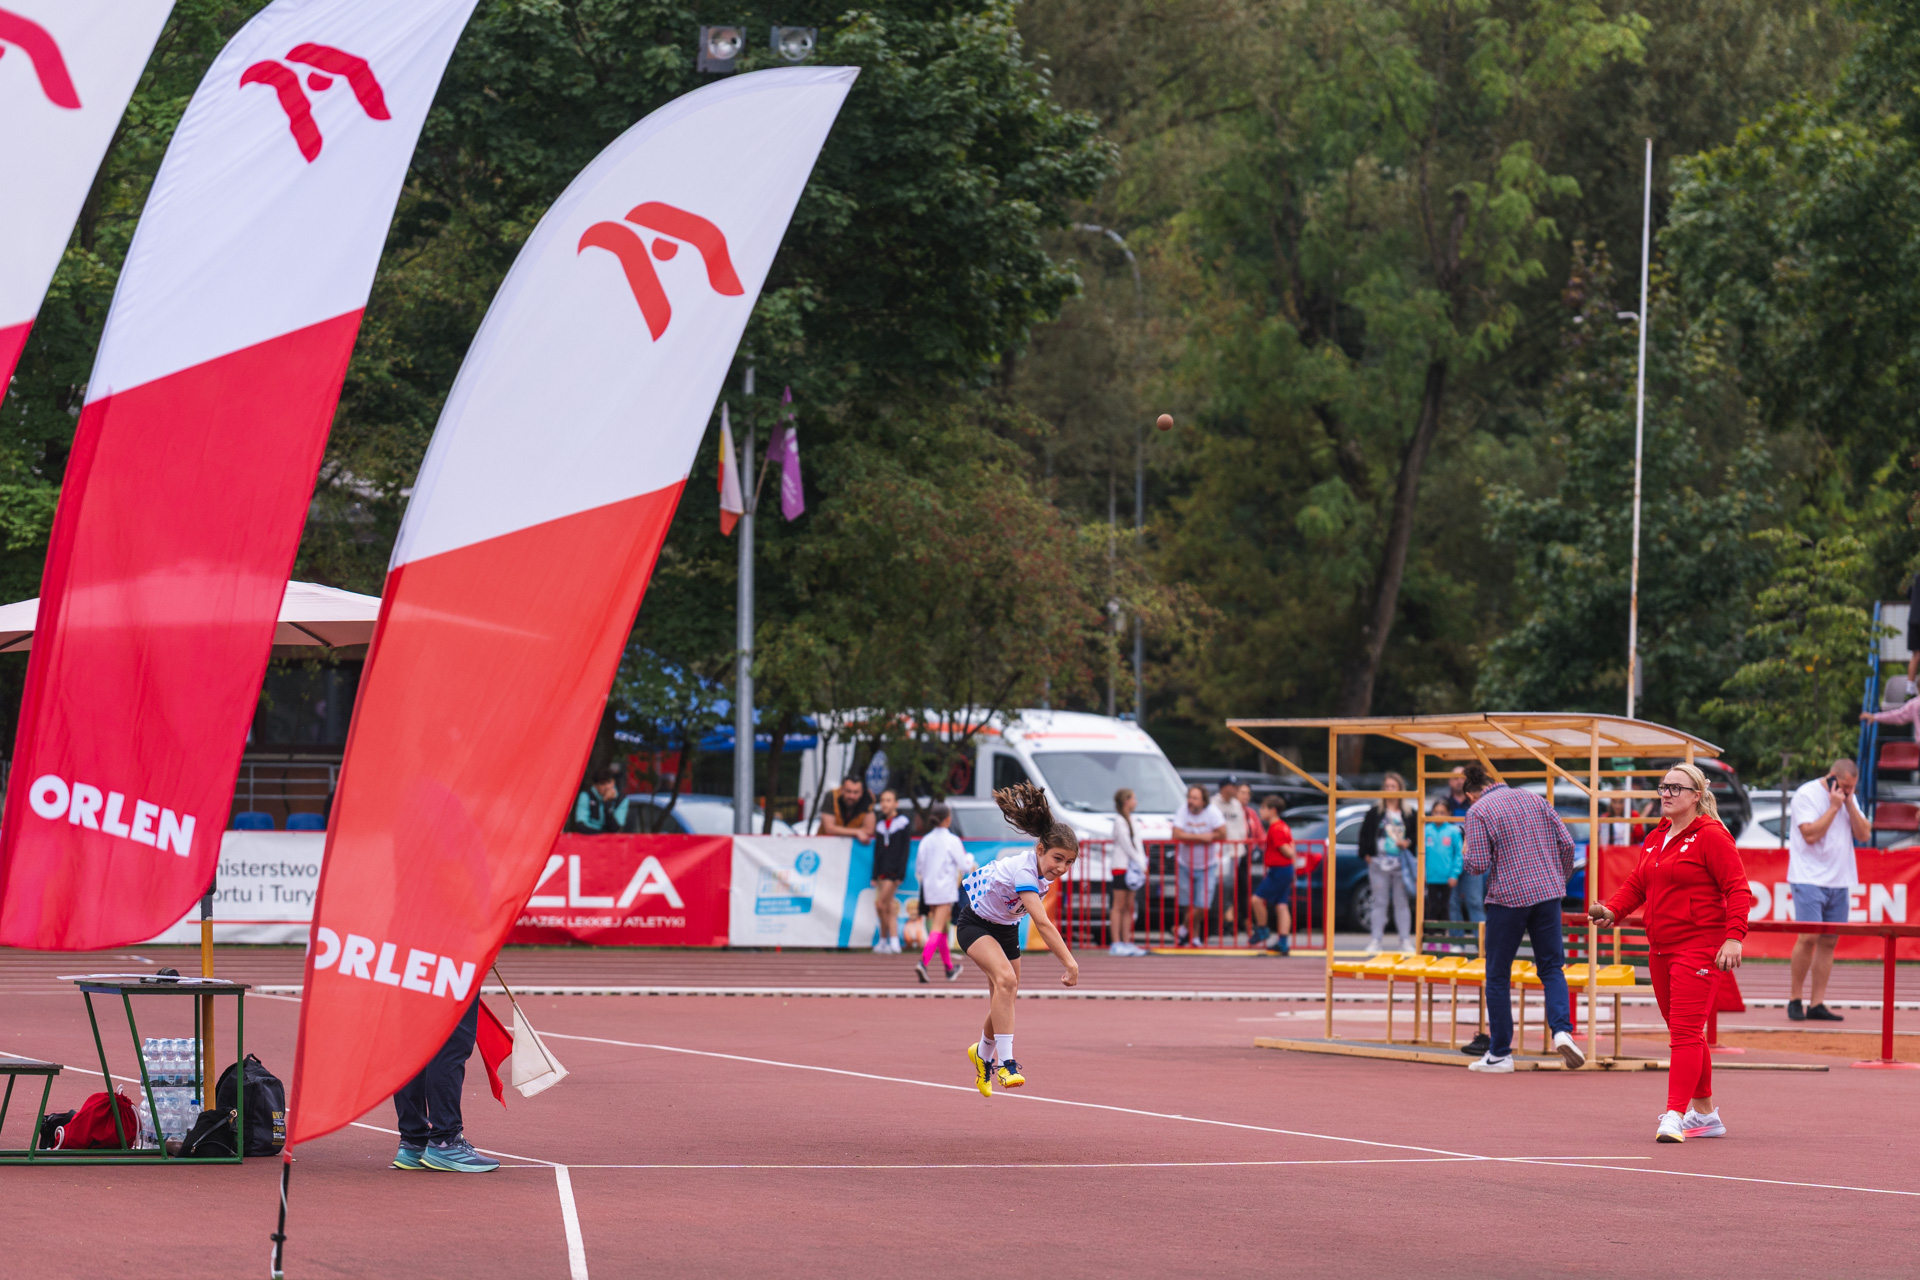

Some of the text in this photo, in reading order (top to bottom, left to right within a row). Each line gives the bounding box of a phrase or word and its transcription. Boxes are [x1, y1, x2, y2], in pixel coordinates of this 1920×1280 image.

[29, 774, 196, 858] ORLEN
[259, 884, 264, 902] i
[525, 854, 685, 909] ZLA
[1748, 880, 1907, 924] OREN
[567, 915, 622, 928] LEKKIEJ
[623, 915, 686, 928] ATLETYKI
[313, 926, 476, 1001] ORLEN
